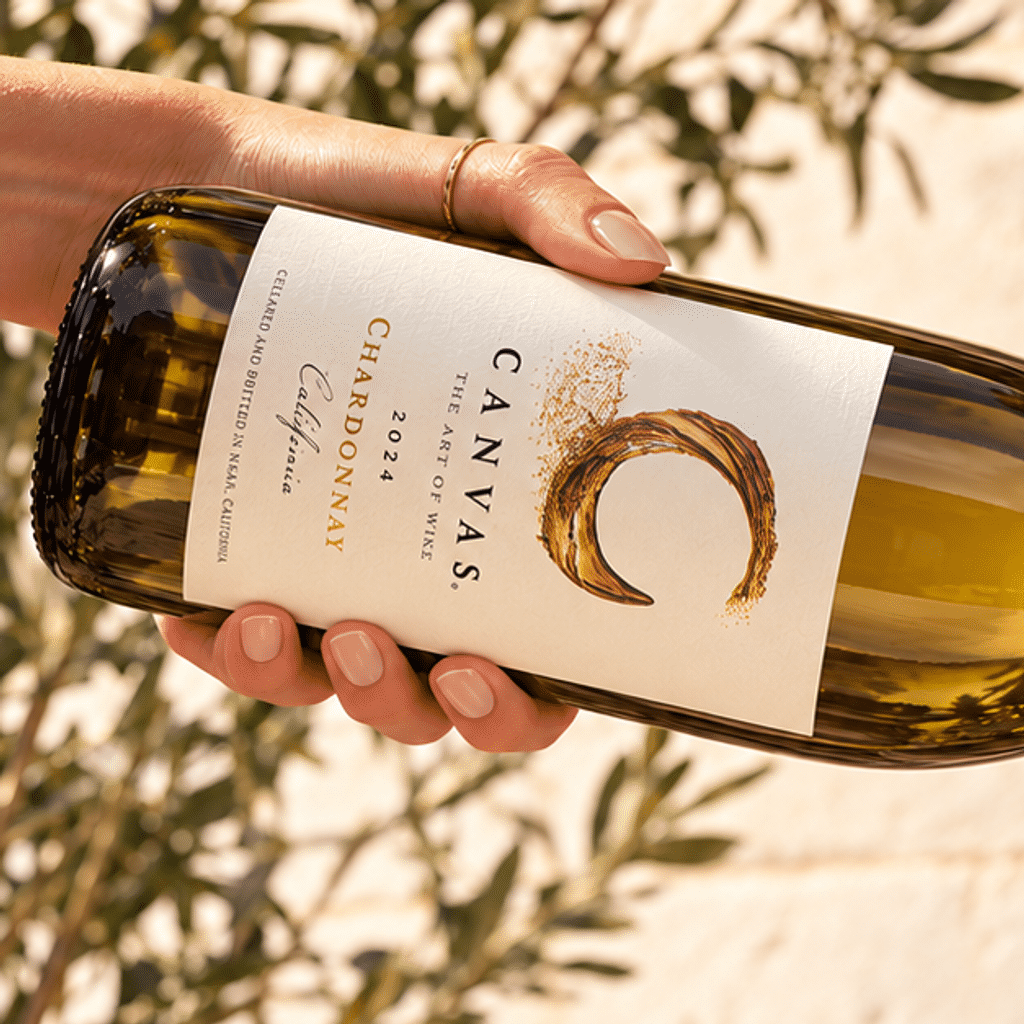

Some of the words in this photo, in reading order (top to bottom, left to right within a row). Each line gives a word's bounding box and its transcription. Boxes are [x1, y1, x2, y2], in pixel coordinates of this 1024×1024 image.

[447, 371, 468, 414] THE
[325, 317, 391, 552] CHARDONNAY
[380, 410, 406, 482] 2024
[436, 423, 454, 467] ART
[430, 474, 444, 503] OF
[452, 347, 522, 582] CANVAS
